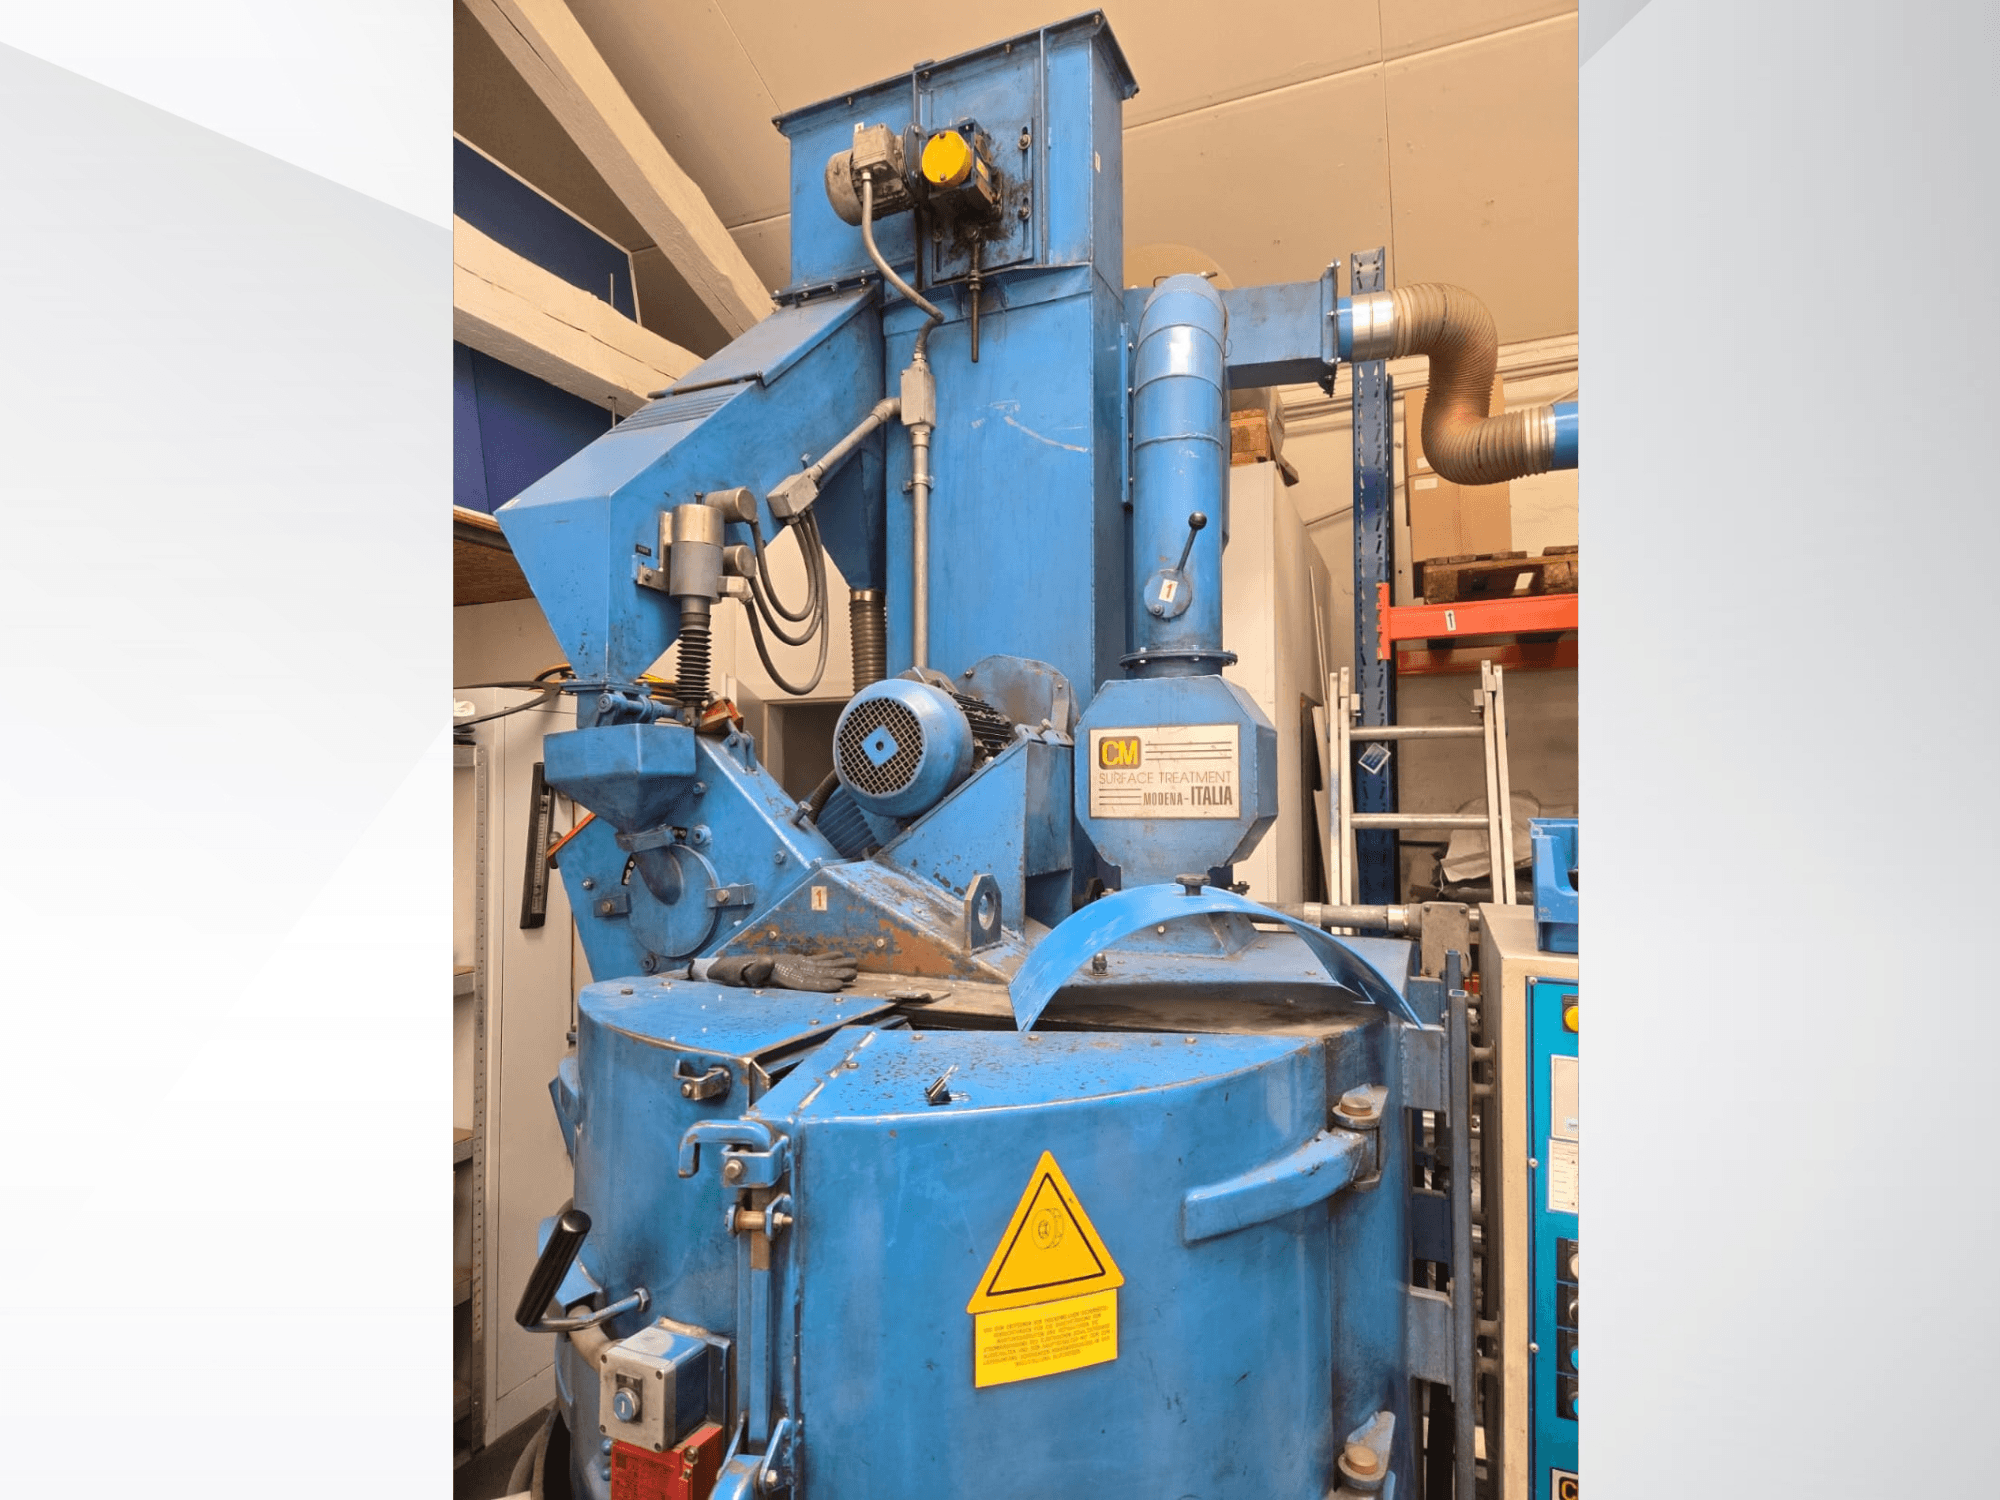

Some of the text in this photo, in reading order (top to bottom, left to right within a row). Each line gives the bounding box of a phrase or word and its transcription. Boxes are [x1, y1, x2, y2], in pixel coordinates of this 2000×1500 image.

[1166, 583, 1173, 599] 1
[1101, 740, 1138, 766] CM
[1099, 770, 1232, 784] SURFACE TREATMENT
[816, 890, 822, 907] 1
